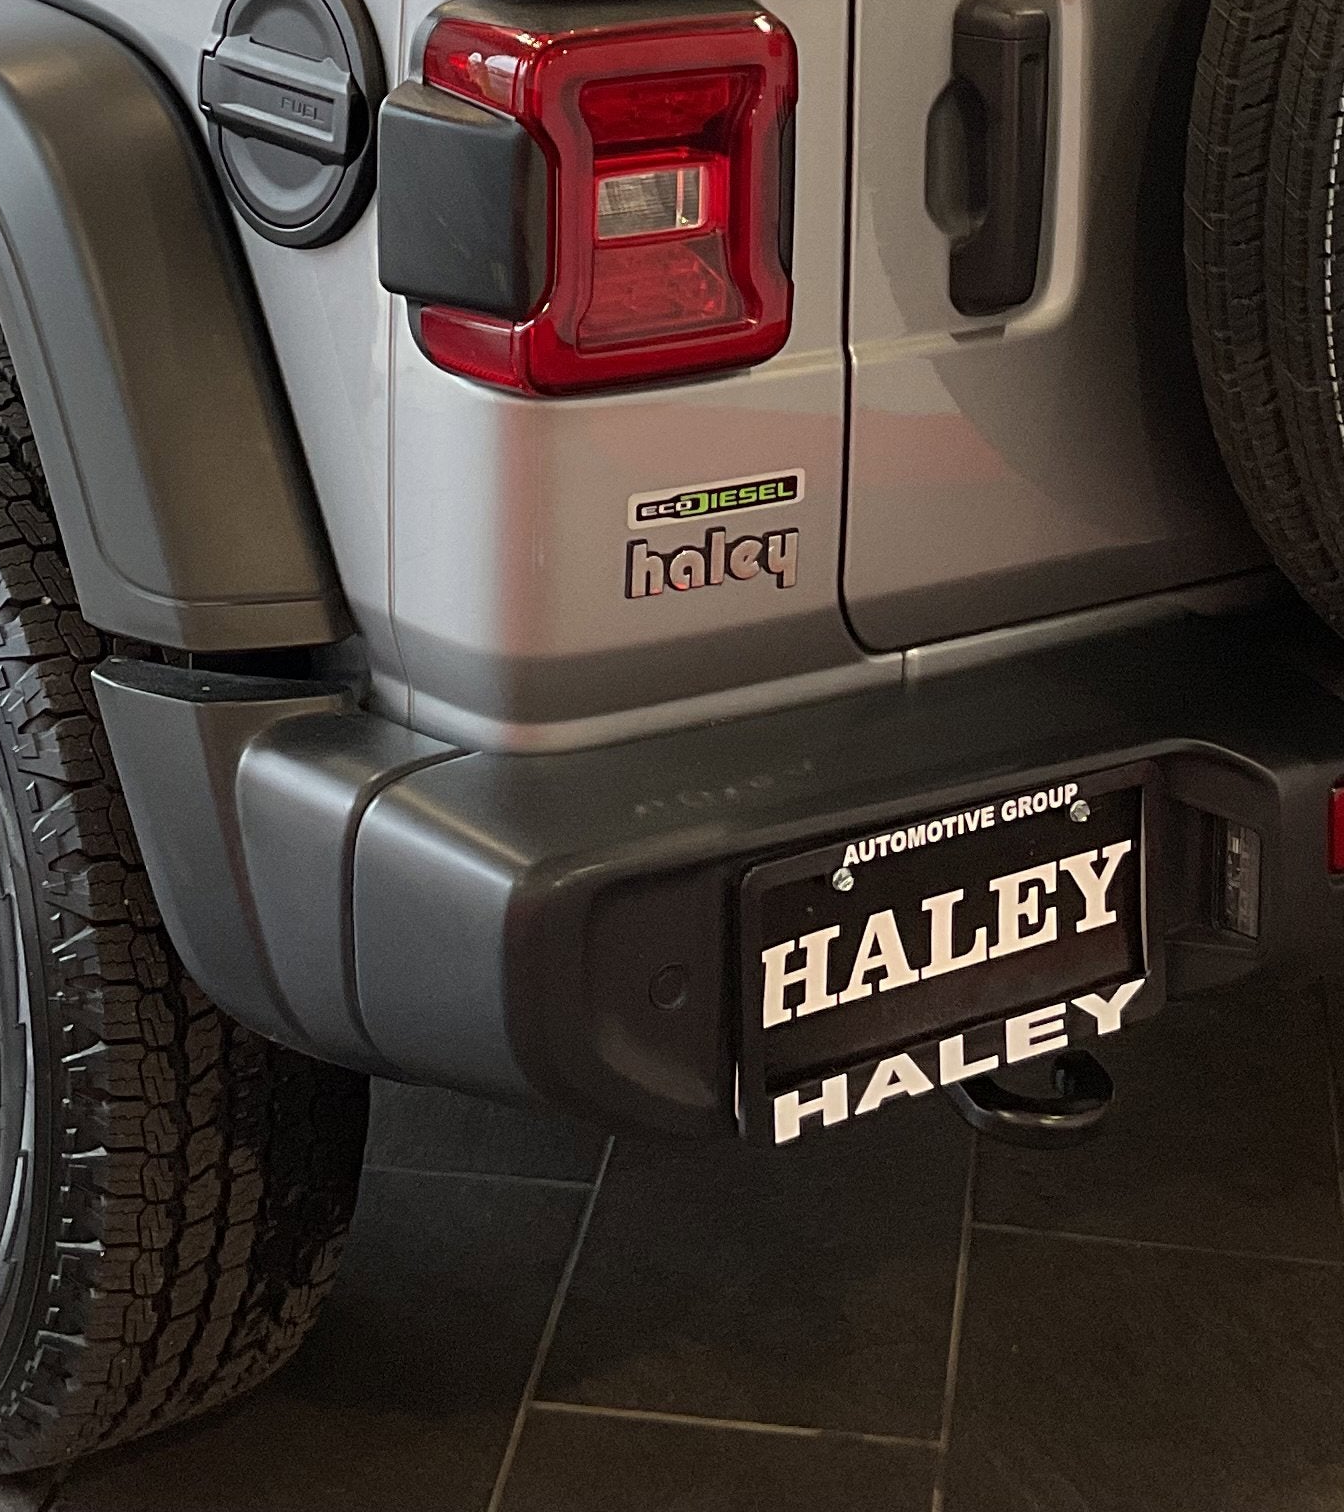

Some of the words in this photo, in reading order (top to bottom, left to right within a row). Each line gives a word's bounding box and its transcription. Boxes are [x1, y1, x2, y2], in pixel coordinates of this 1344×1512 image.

[281, 96, 325, 123] FUEL
[625, 526, 799, 599] haley
[843, 806, 995, 867] AUTOMOTIVE
[1001, 783, 1078, 822] GROUP
[761, 839, 1132, 1029] HALEY
[773, 978, 1146, 1144] HALEY
